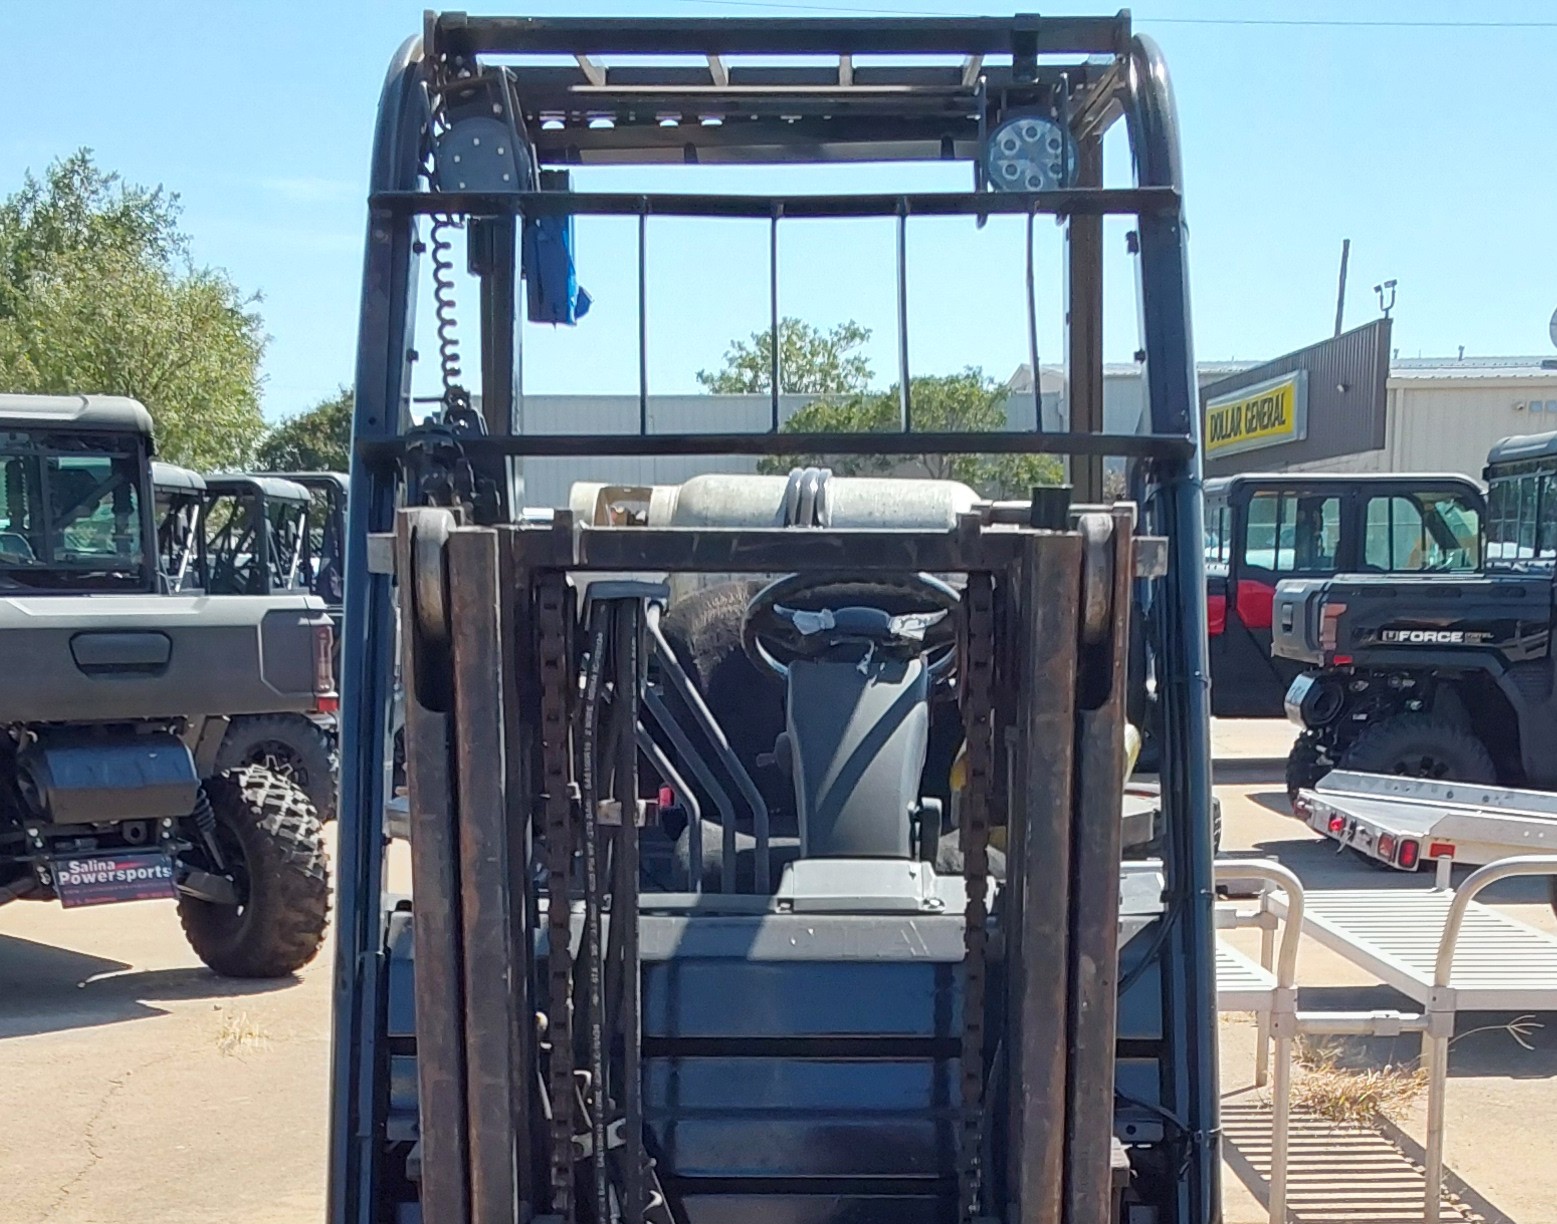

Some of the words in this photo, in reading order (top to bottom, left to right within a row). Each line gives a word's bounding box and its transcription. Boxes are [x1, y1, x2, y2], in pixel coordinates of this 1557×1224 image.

[1210, 406, 1242, 443] DOLLAR
[1244, 392, 1286, 434] GENERAL
[58, 865, 172, 886] Powersports
[68, 860, 116, 874] Salina
